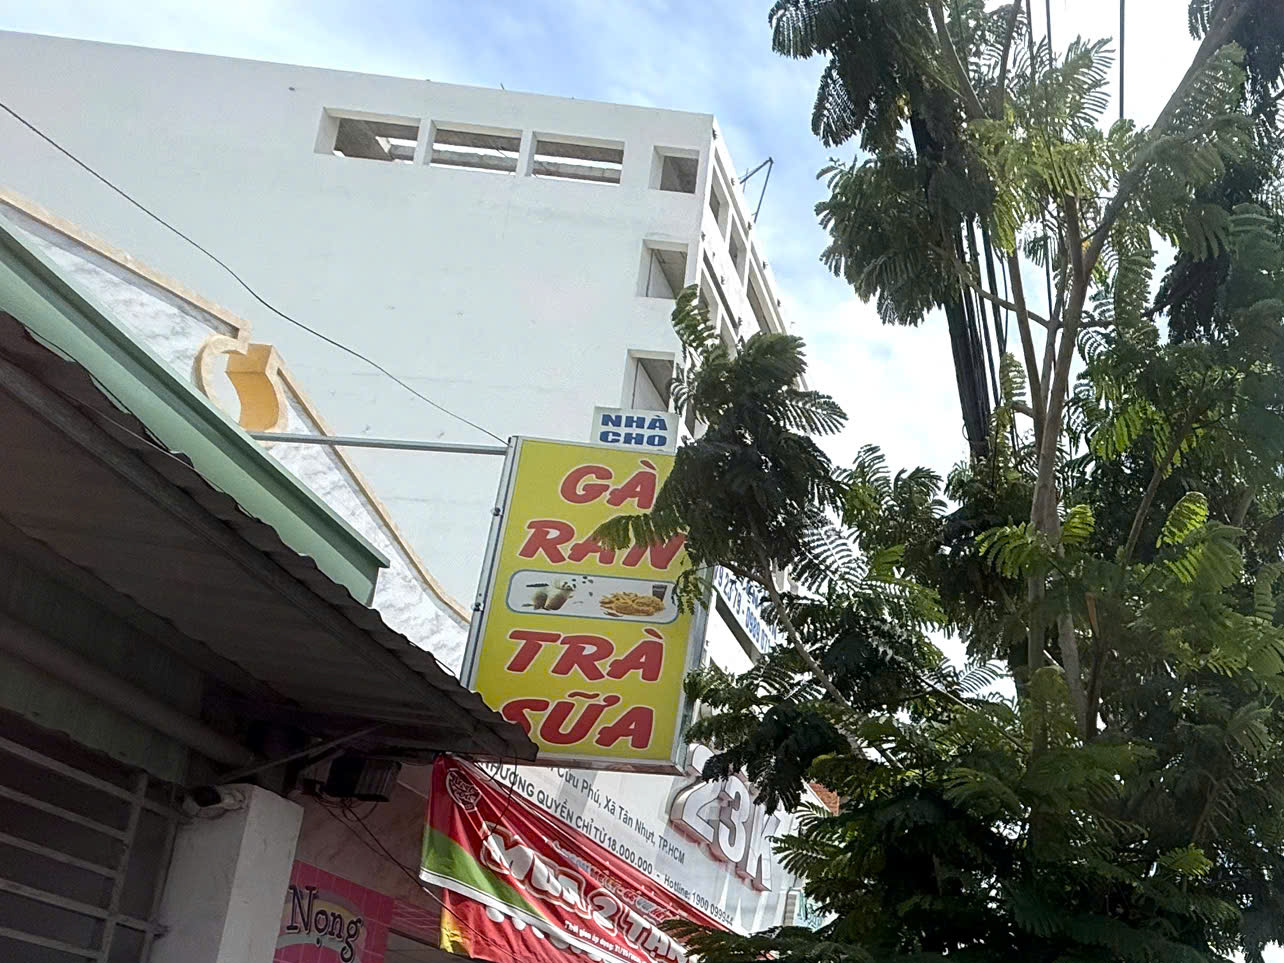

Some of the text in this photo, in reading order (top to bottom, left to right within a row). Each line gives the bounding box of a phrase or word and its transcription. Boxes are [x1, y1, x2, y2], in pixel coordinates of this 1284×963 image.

[599, 431, 668, 447] CHO
[600, 413, 668, 431] NHÀ
[560, 460, 658, 510] GÀ
[506, 627, 664, 682] TRÀ
[501, 690, 654, 750] SỮA
[537, 789, 574, 823] QUYỀN
[575, 815, 594, 834] CHỈ
[594, 824, 607, 844] TỪ
[607, 836, 653, 875] 18.000.000
[663, 873, 691, 900] Hotline:
[692, 892, 709, 912] 1900
[580, 779, 601, 808] Phú,
[603, 795, 616, 816] Xã
[618, 805, 634, 826] Tân
[658, 834, 686, 865] TP.HCM
[286, 884, 363, 963] Nọng
